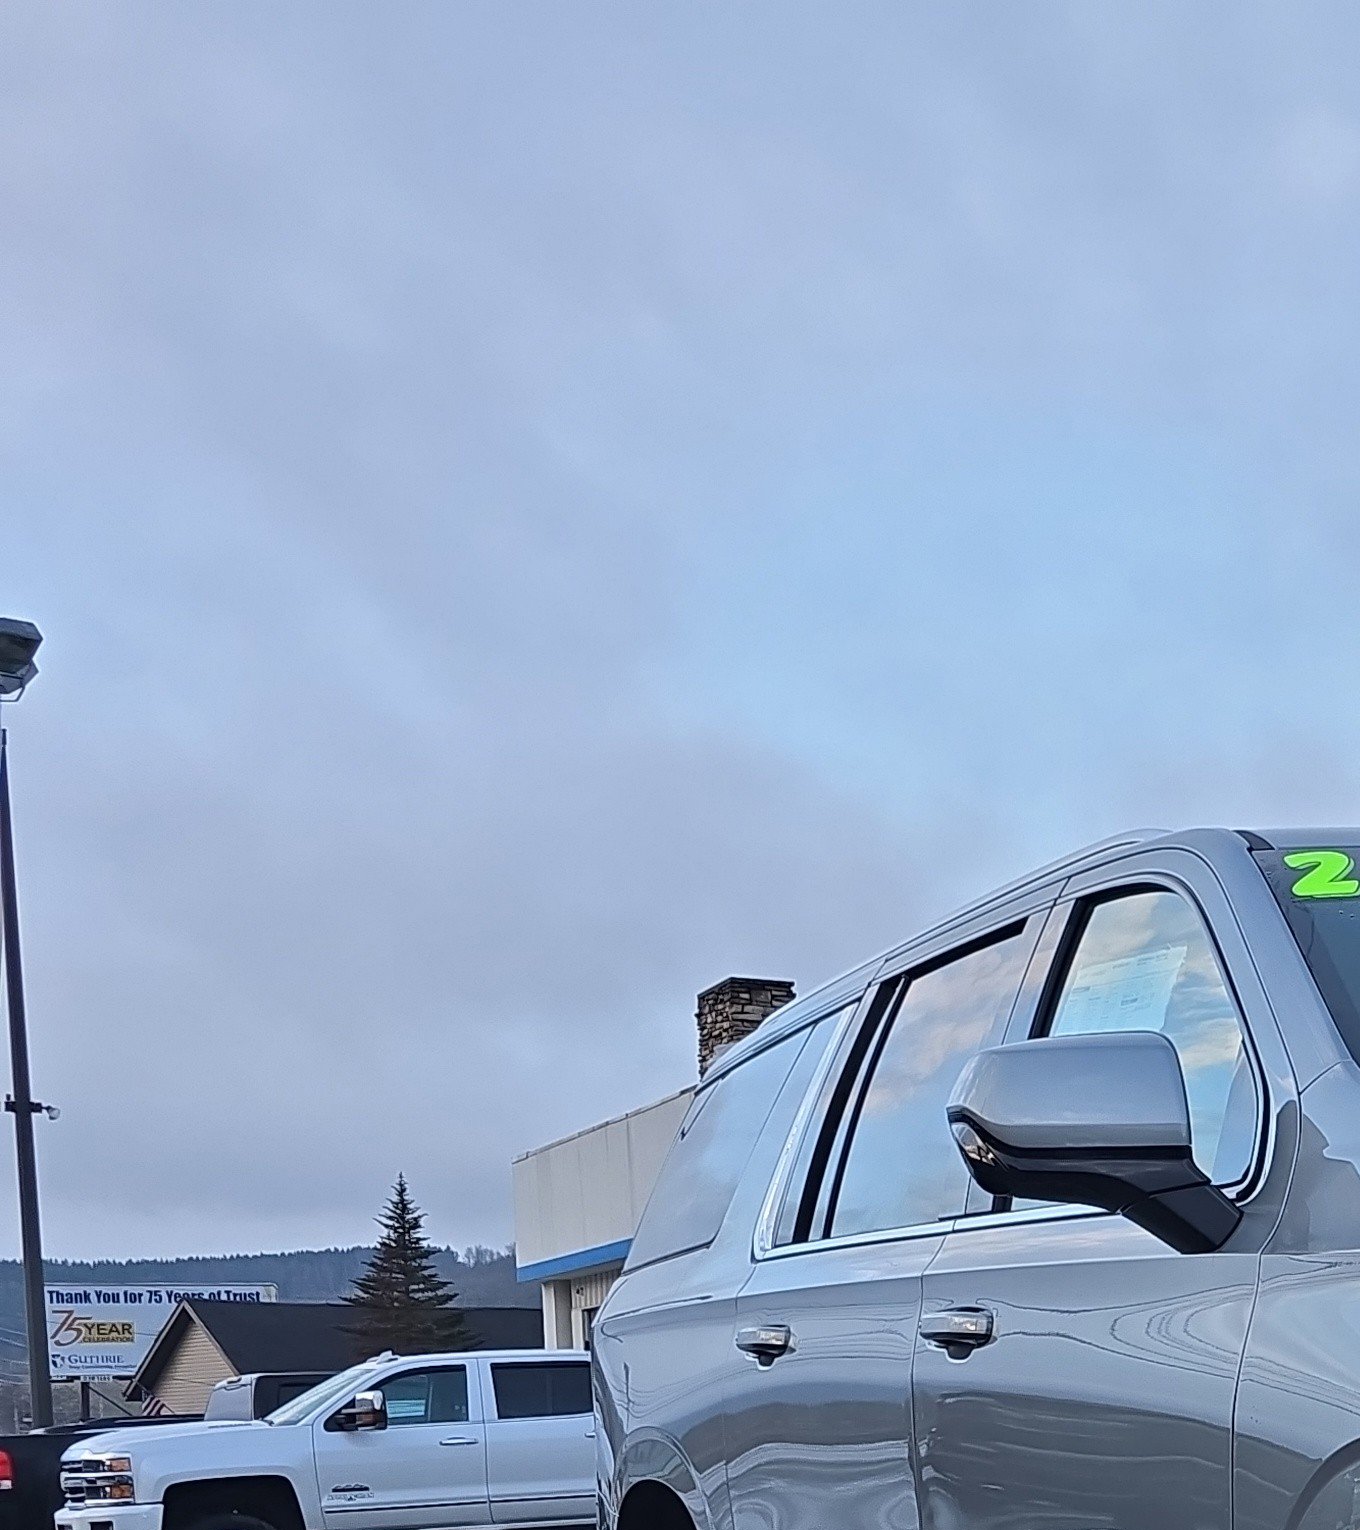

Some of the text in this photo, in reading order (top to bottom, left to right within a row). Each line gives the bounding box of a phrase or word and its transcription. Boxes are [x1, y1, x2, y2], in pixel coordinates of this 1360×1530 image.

[47, 1290, 92, 1304] Thank
[95, 1290, 121, 1304] You
[124, 1290, 144, 1304] for
[146, 1290, 163, 1304] 75
[224, 1290, 261, 1302] Trust
[50, 1310, 92, 1347] 75
[83, 1322, 133, 1336] YEAR
